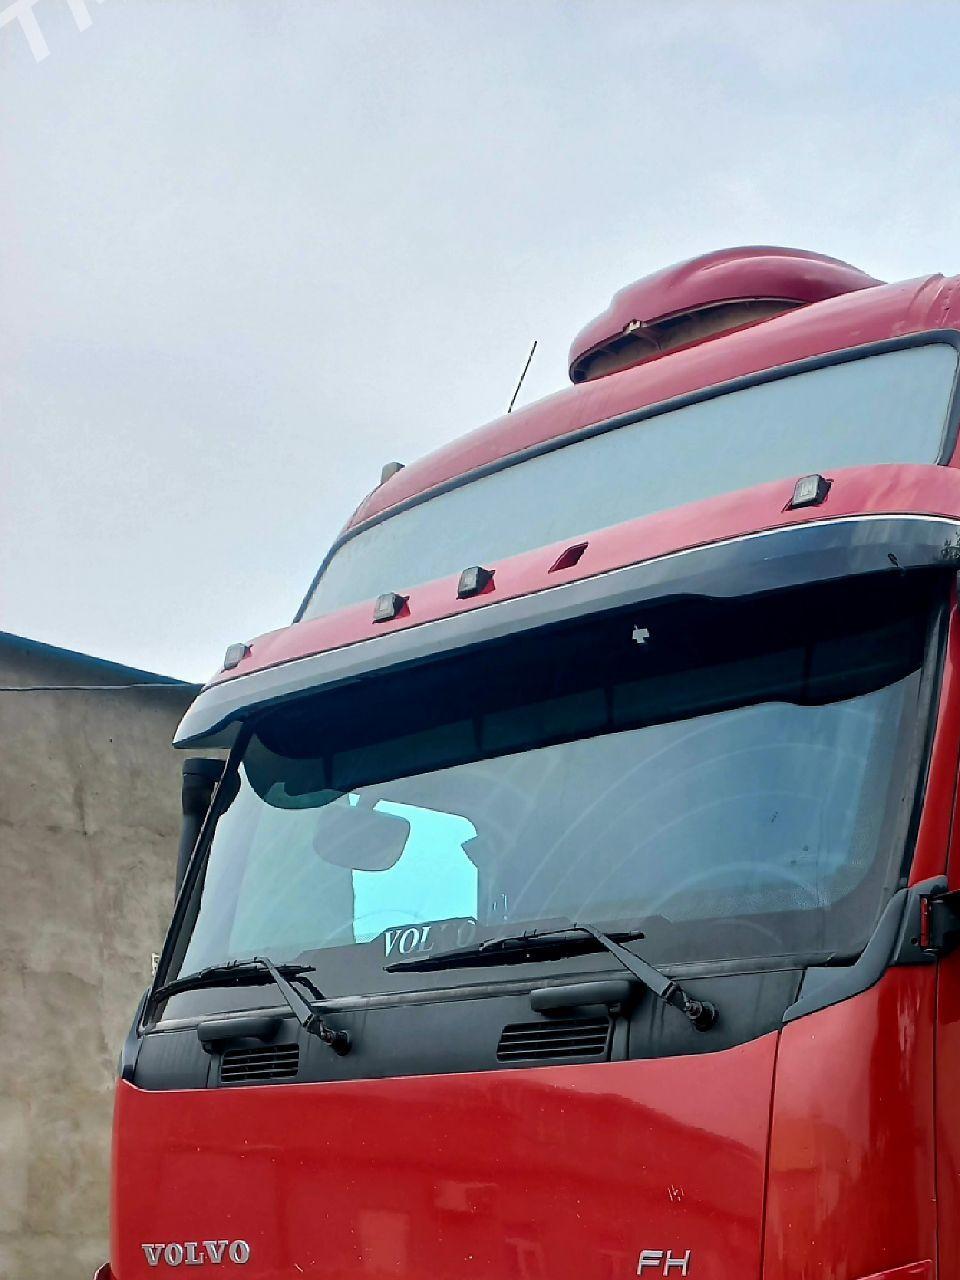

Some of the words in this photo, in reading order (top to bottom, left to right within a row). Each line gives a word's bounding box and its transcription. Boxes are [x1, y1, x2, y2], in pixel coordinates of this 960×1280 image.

[383, 918, 477, 958] VOLO
[141, 1239, 250, 1267] VOLVO
[636, 1249, 691, 1277] FH
